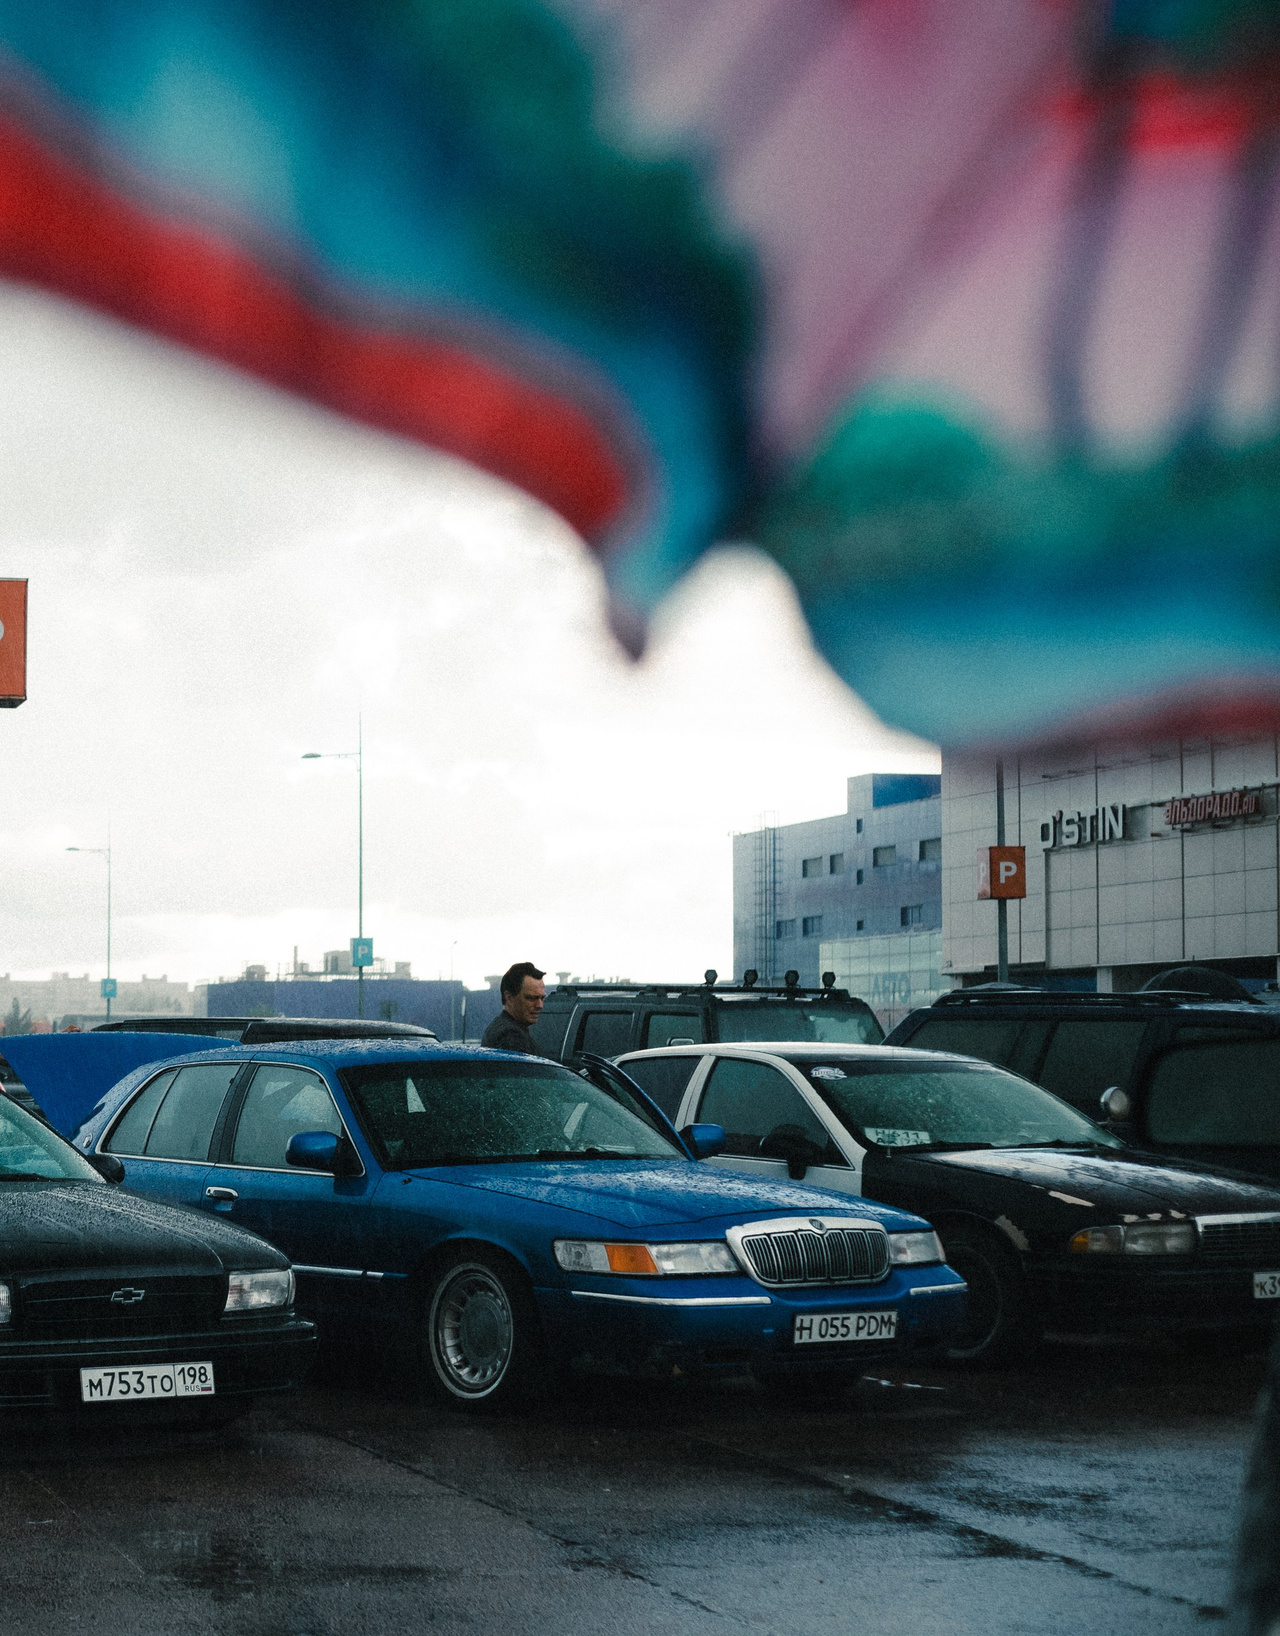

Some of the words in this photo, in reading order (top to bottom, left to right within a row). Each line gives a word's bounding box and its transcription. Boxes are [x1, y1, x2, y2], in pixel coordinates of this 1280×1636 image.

[999, 861, 1018, 884] P
[358, 945, 369, 959] P
[1259, 1275, 1280, 1296] К3
[819, 1316, 850, 1338] 055
[856, 1314, 893, 1337] PDM
[88, 1370, 173, 1397] М753ТО
[177, 1365, 208, 1384] 198
[184, 1384, 201, 1392] RUS
